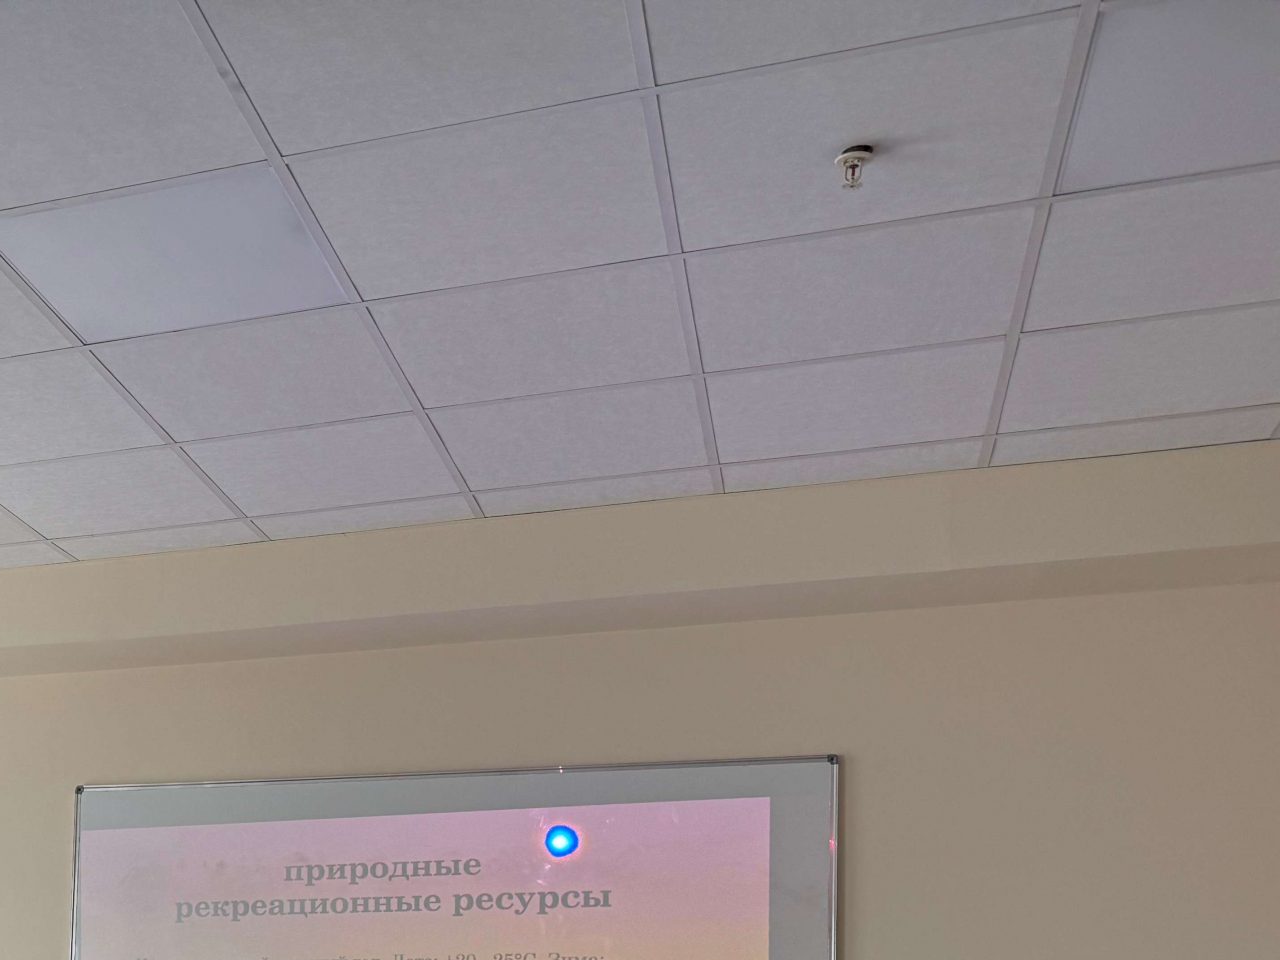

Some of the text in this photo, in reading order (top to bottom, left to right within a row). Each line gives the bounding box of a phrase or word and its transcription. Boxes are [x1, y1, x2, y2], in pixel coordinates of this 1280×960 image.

[284, 856, 482, 886] природные
[174, 888, 612, 922] рекреационные ресурсы
